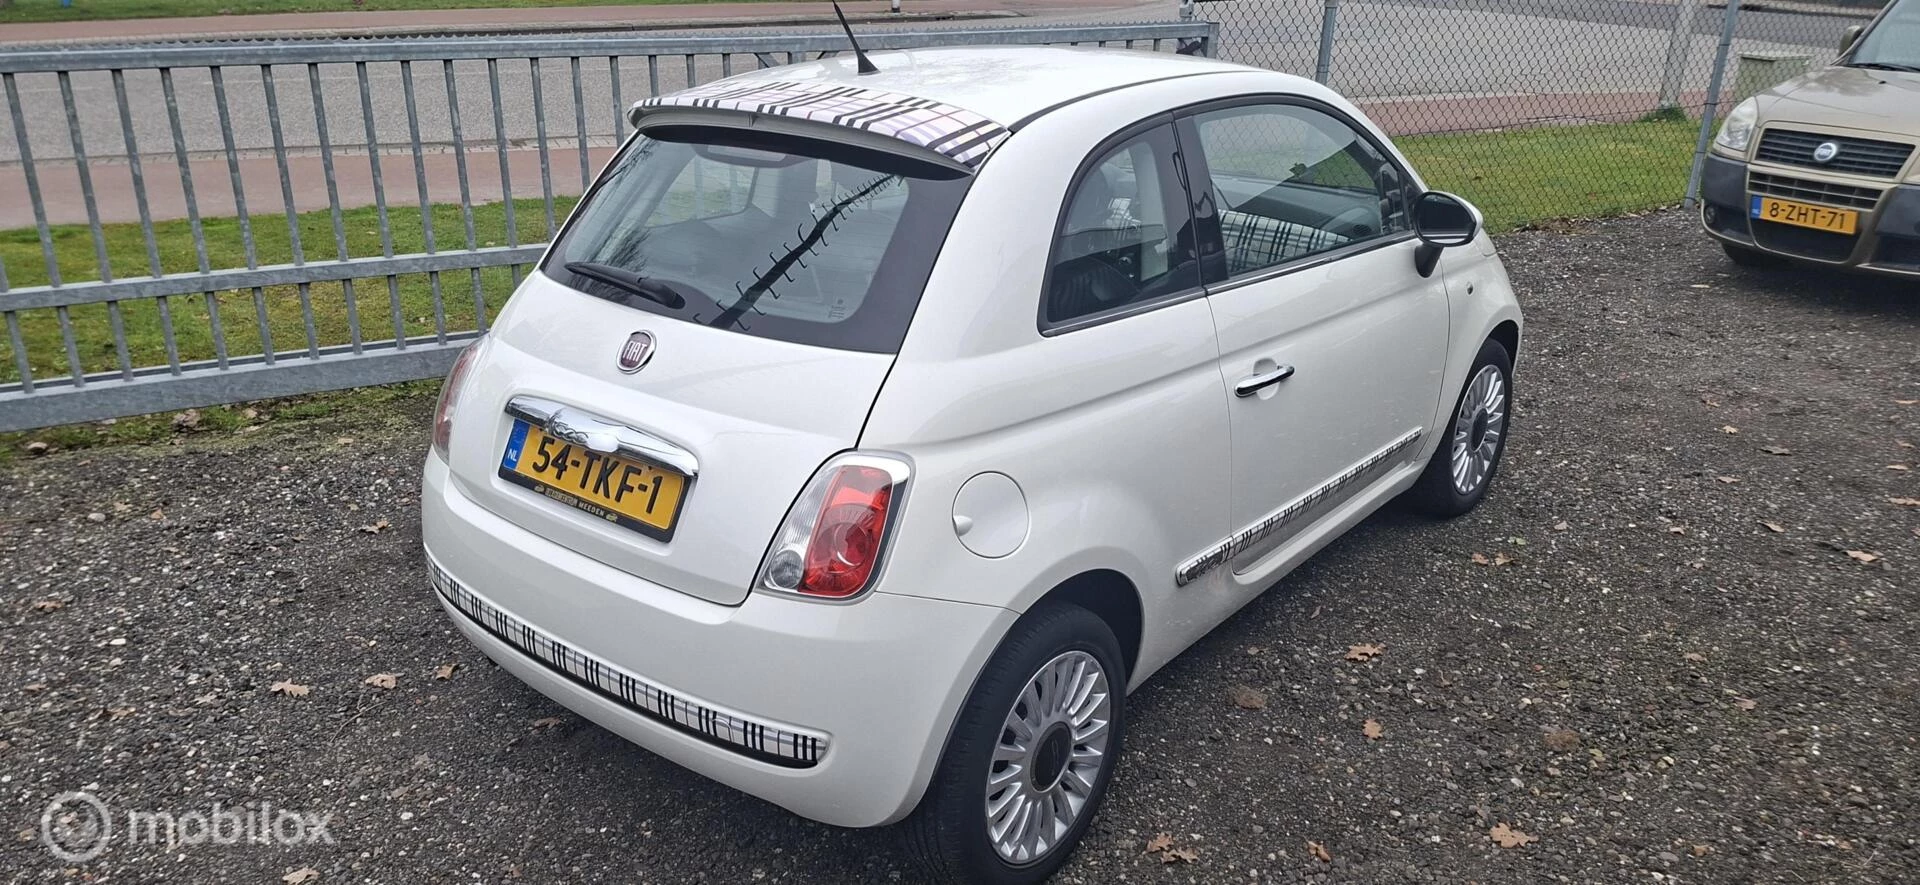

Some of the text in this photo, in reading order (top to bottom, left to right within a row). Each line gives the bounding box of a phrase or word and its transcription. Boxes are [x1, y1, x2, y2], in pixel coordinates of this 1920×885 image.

[1769, 202, 1845, 229] 8-ZHT-71
[622, 340, 648, 362] FIAT
[507, 447, 518, 462] NL
[532, 436, 663, 514] 54-TKF-1
